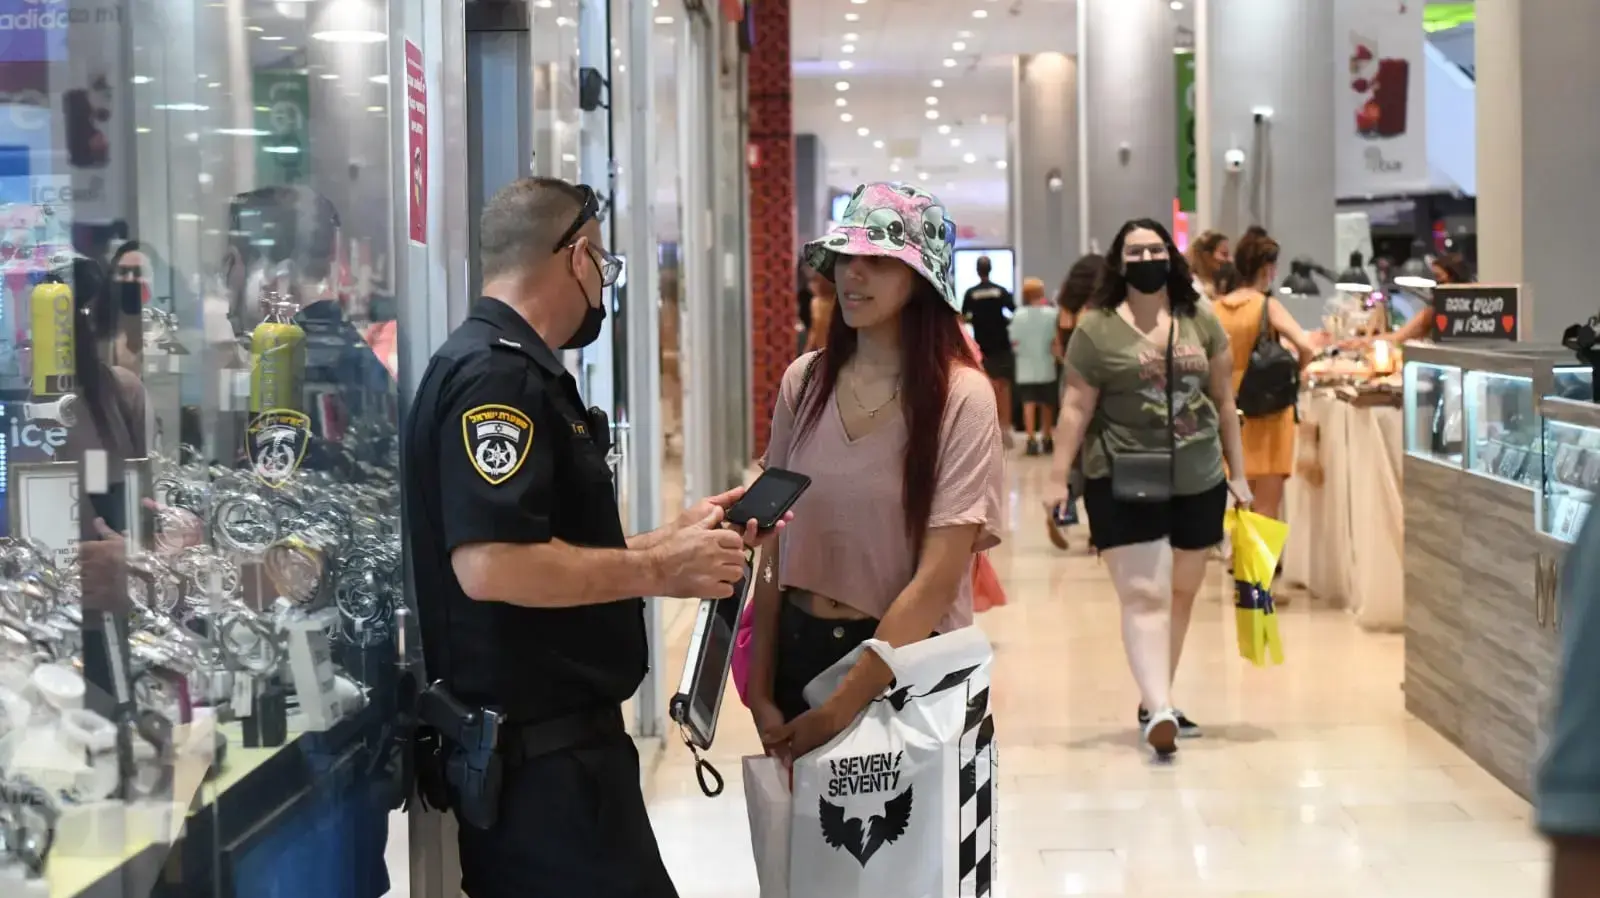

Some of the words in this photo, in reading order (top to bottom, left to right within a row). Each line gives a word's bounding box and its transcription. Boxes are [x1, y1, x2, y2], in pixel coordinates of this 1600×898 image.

[0, 8, 68, 29] adida
[838, 752, 892, 776] SEVEN
[828, 770, 901, 797] SEVENTY
